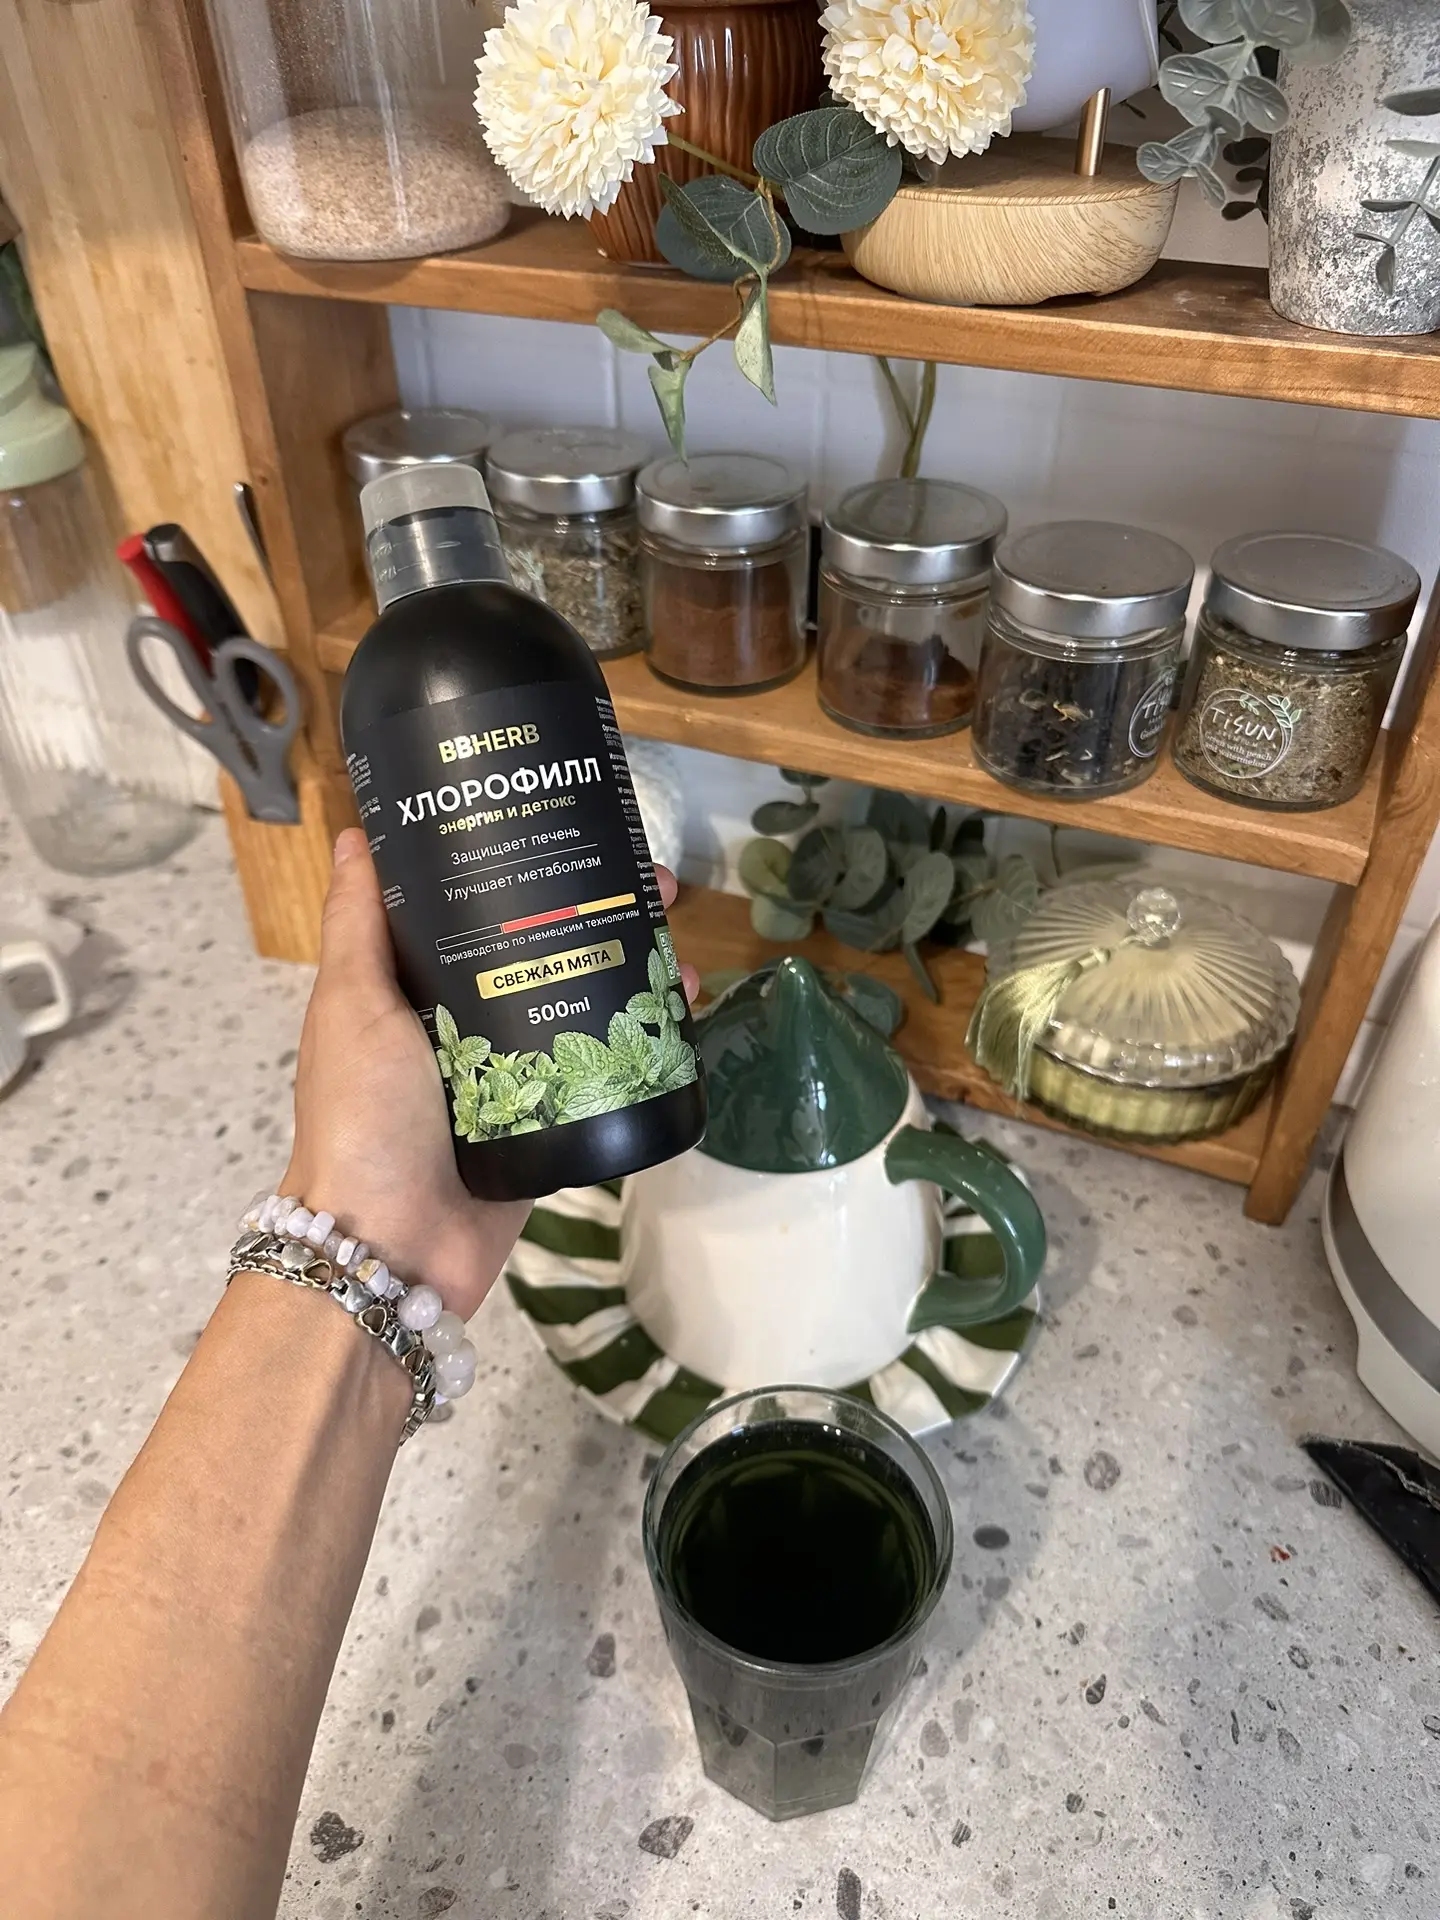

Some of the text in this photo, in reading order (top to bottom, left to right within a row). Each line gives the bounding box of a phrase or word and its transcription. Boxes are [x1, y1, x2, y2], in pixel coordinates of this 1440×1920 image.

[438, 723, 541, 764] BBHERB
[1219, 749, 1267, 769] watermelon
[1227, 743, 1246, 756] with
[1246, 750, 1272, 761] peach
[396, 757, 602, 826] ХЛОРОФИЛЛ
[438, 793, 577, 836] энергия и детокс
[451, 825, 582, 866] Защищает печень
[444, 856, 602, 902] Улучшает метаболизм
[440, 941, 510, 965] Производство
[512, 935, 526, 947] по
[528, 922, 584, 943] немецким
[585, 909, 641, 929] технологиям
[493, 949, 612, 990] СВЕЖАЯ МЯТА
[527, 996, 592, 1025] 500ml
